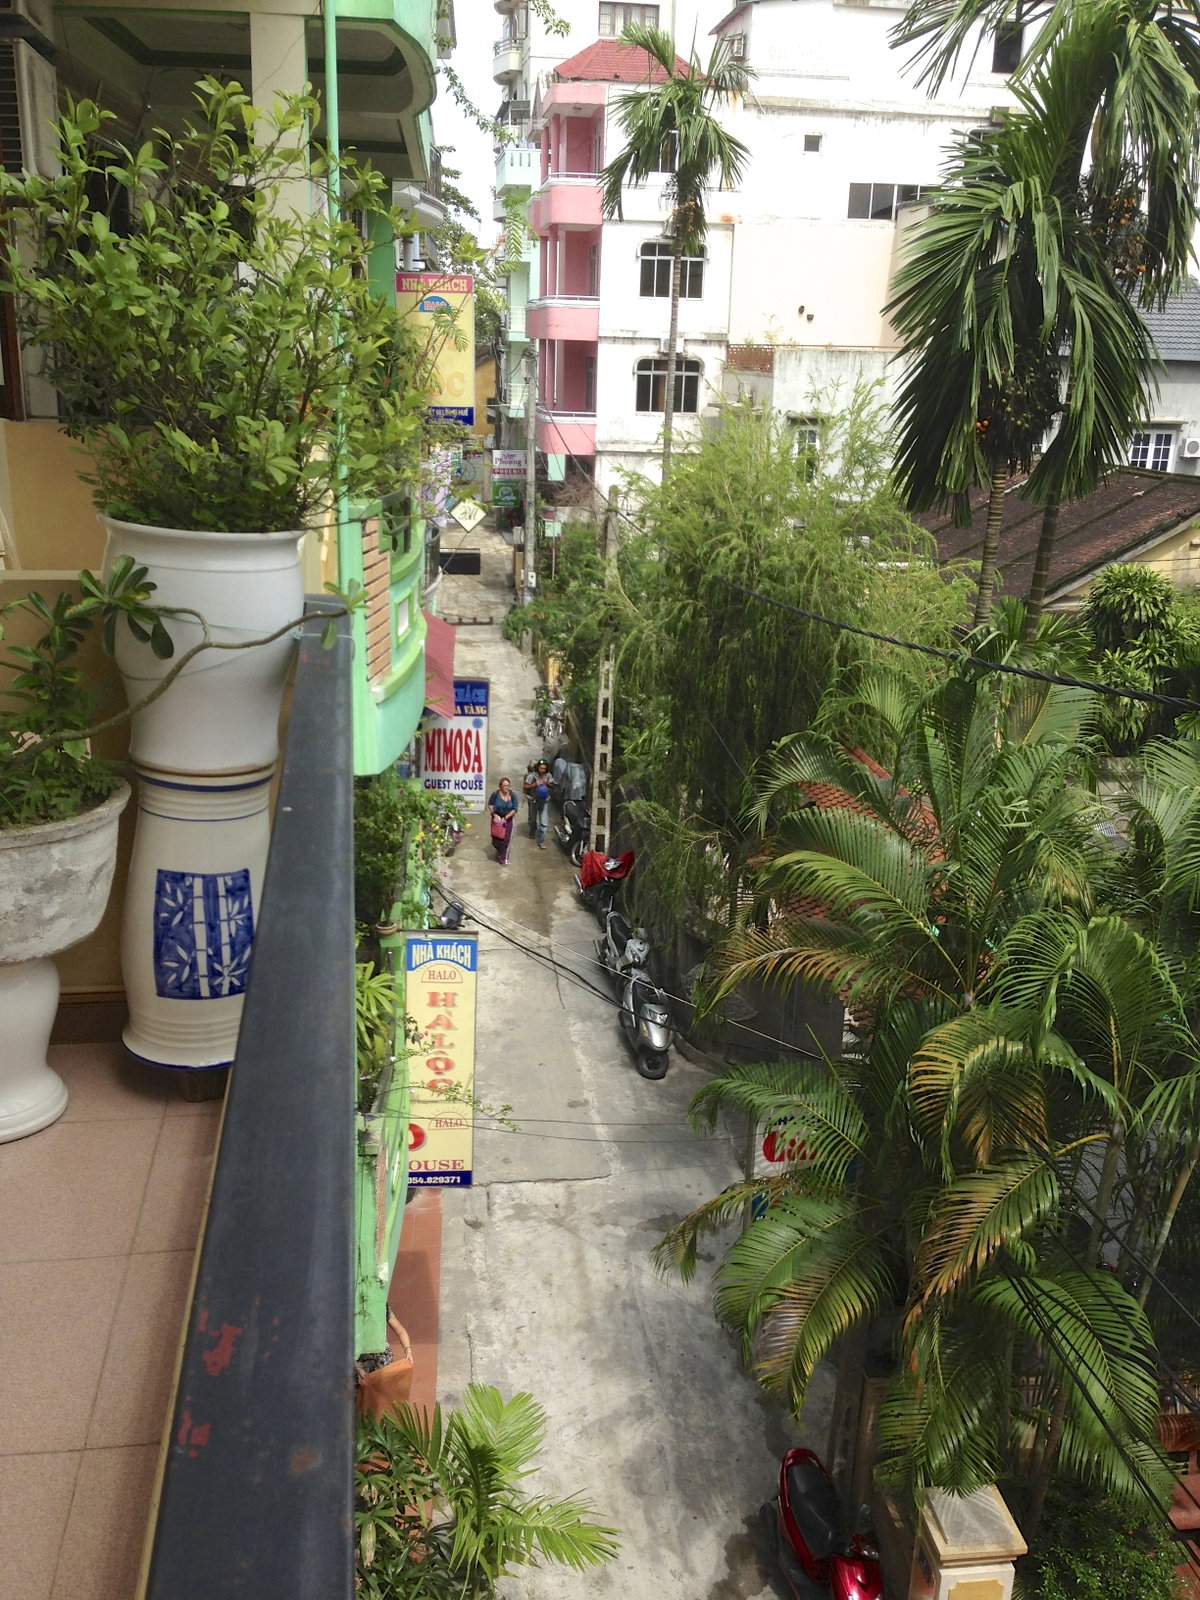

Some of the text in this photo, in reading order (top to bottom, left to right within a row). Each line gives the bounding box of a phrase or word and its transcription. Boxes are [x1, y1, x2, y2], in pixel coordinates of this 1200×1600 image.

[463, 703, 487, 714] VÀNG
[424, 728, 483, 773] MIMOSA
[424, 778, 484, 791] GUEST HOUSE
[412, 941, 471, 969] NHÀ KHÁCH
[428, 970, 457, 980] HALO
[435, 1118, 463, 1128] HALO
[408, 1159, 464, 1171] OUSE
